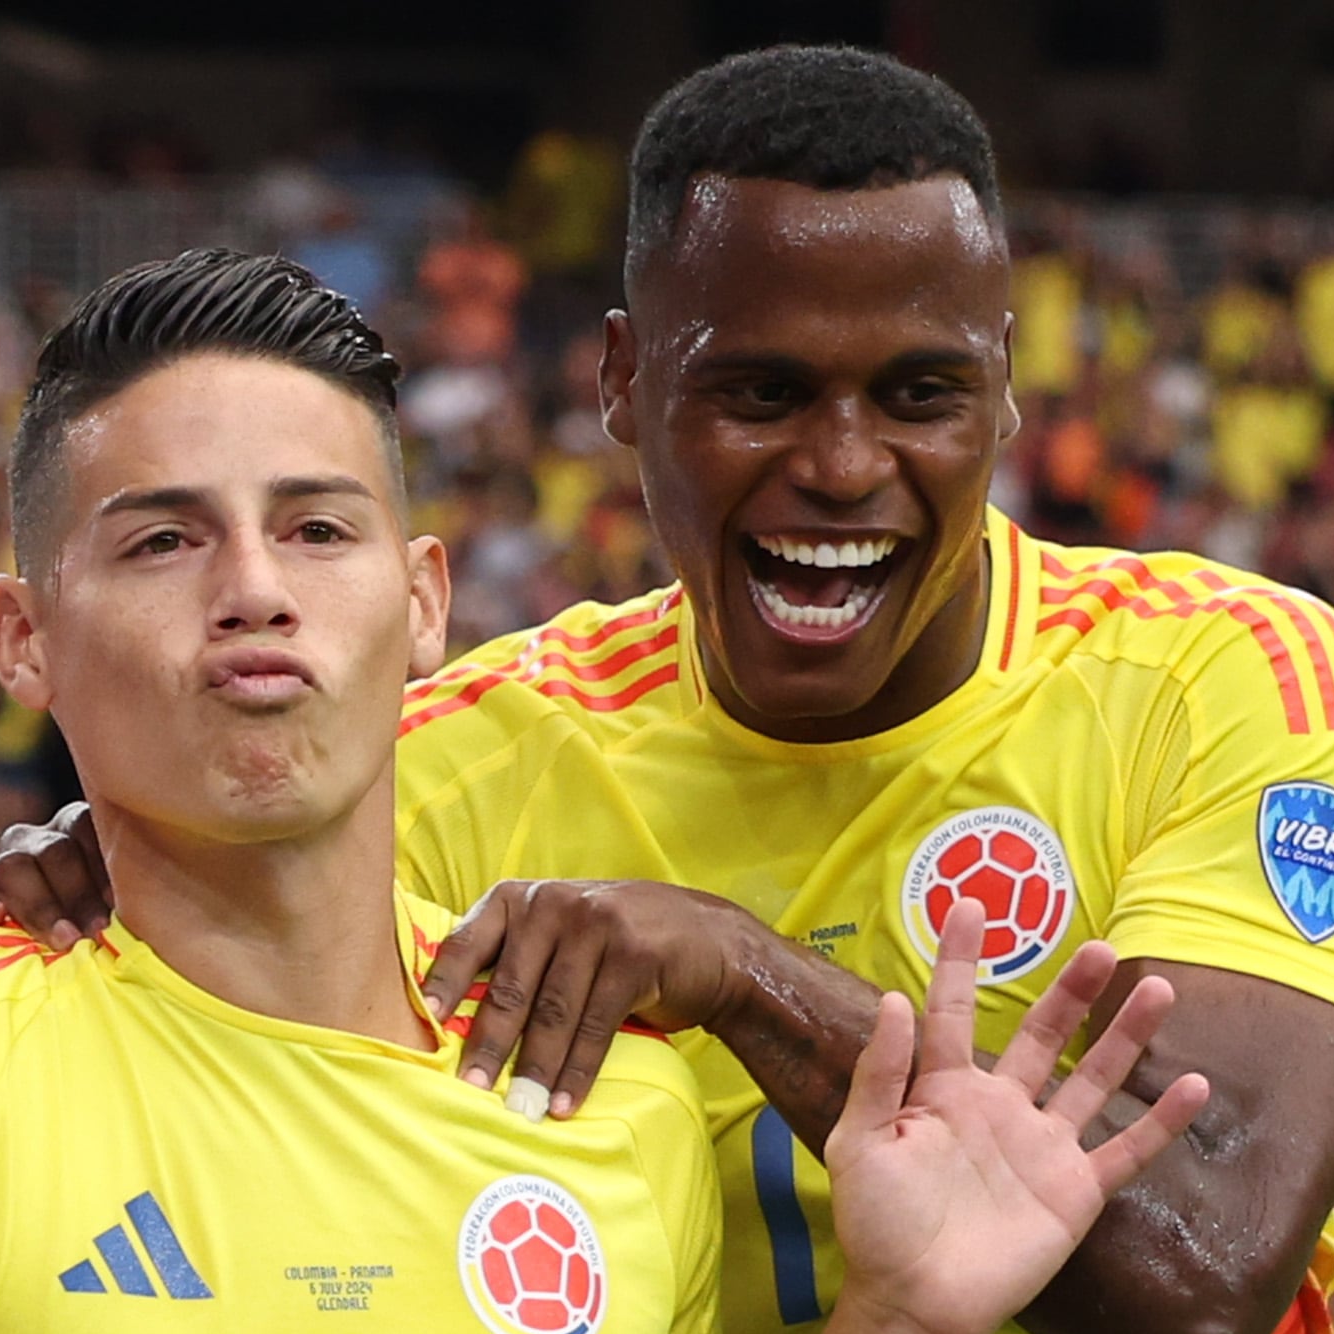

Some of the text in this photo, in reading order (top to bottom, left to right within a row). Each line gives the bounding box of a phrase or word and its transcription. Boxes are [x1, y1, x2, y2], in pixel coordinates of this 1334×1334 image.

[951, 813, 1029, 835] COLOMBIANA
[1027, 826, 1043, 842] DE
[1273, 846, 1291, 858] EL
[498, 1181, 567, 1209] COLOMBIANA
[565, 1204, 579, 1221] DE
[284, 1266, 338, 1280] COLOMBIA
[350, 1265, 395, 1279] PANAMA
[320, 1282, 343, 1295] JULY
[345, 1281, 373, 1295] 2024
[317, 1297, 370, 1311] GLENDALE
